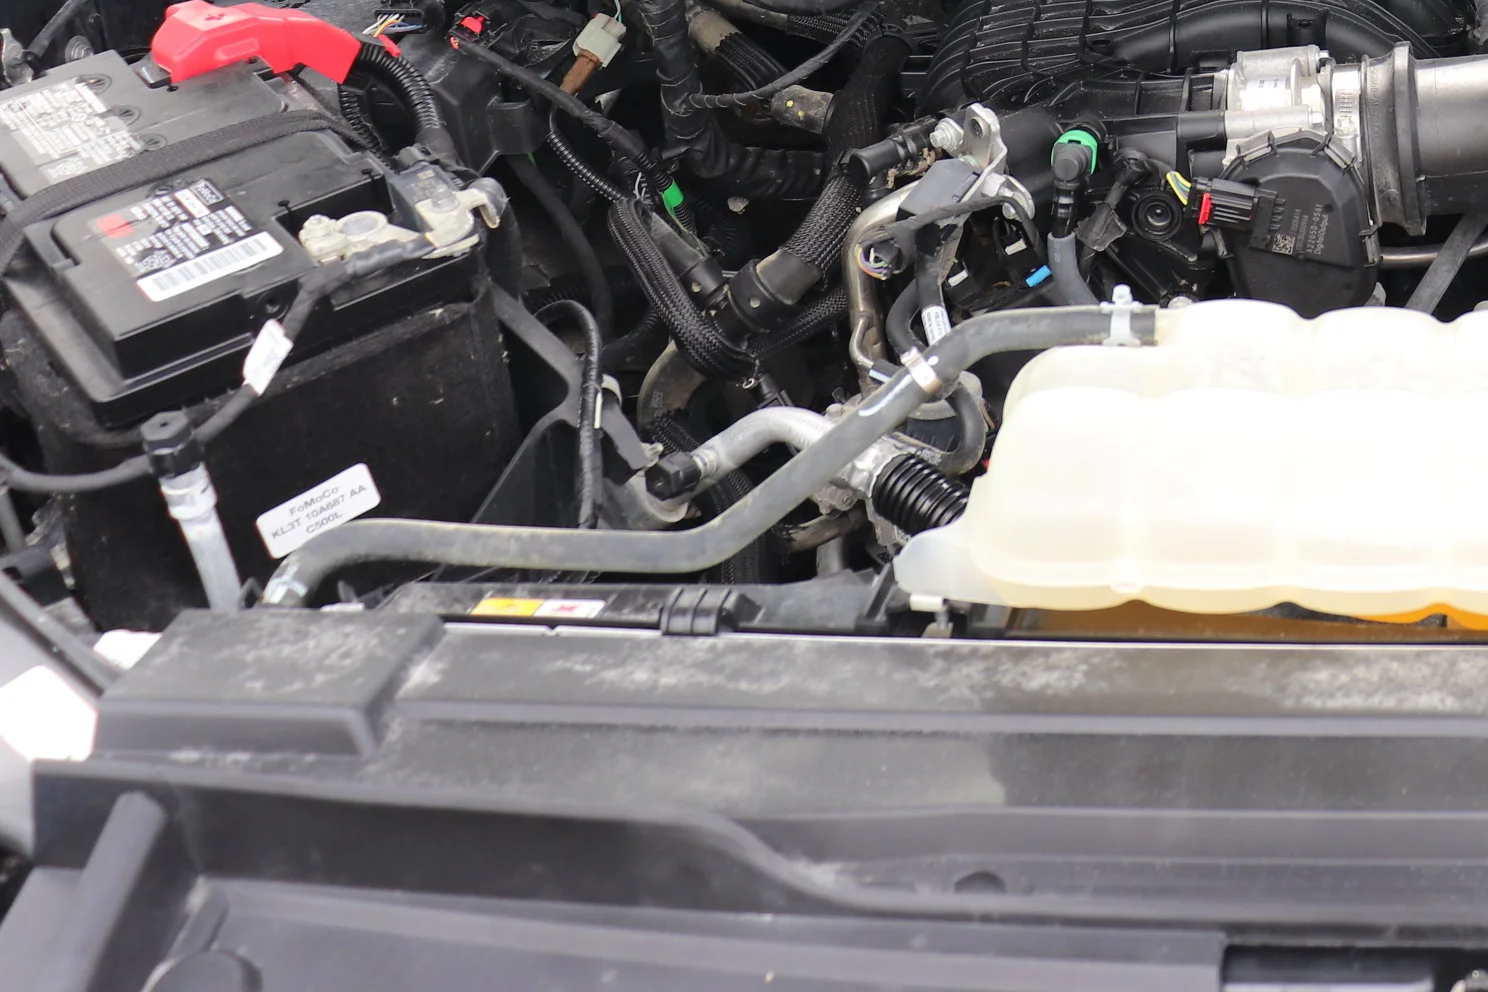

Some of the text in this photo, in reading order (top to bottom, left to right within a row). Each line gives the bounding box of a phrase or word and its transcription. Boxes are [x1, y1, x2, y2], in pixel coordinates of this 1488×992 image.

[271, 518, 302, 539] KL3T
[349, 485, 367, 498] AA
[288, 487, 339, 517] FoMoCo
[305, 512, 343, 534] C500L
